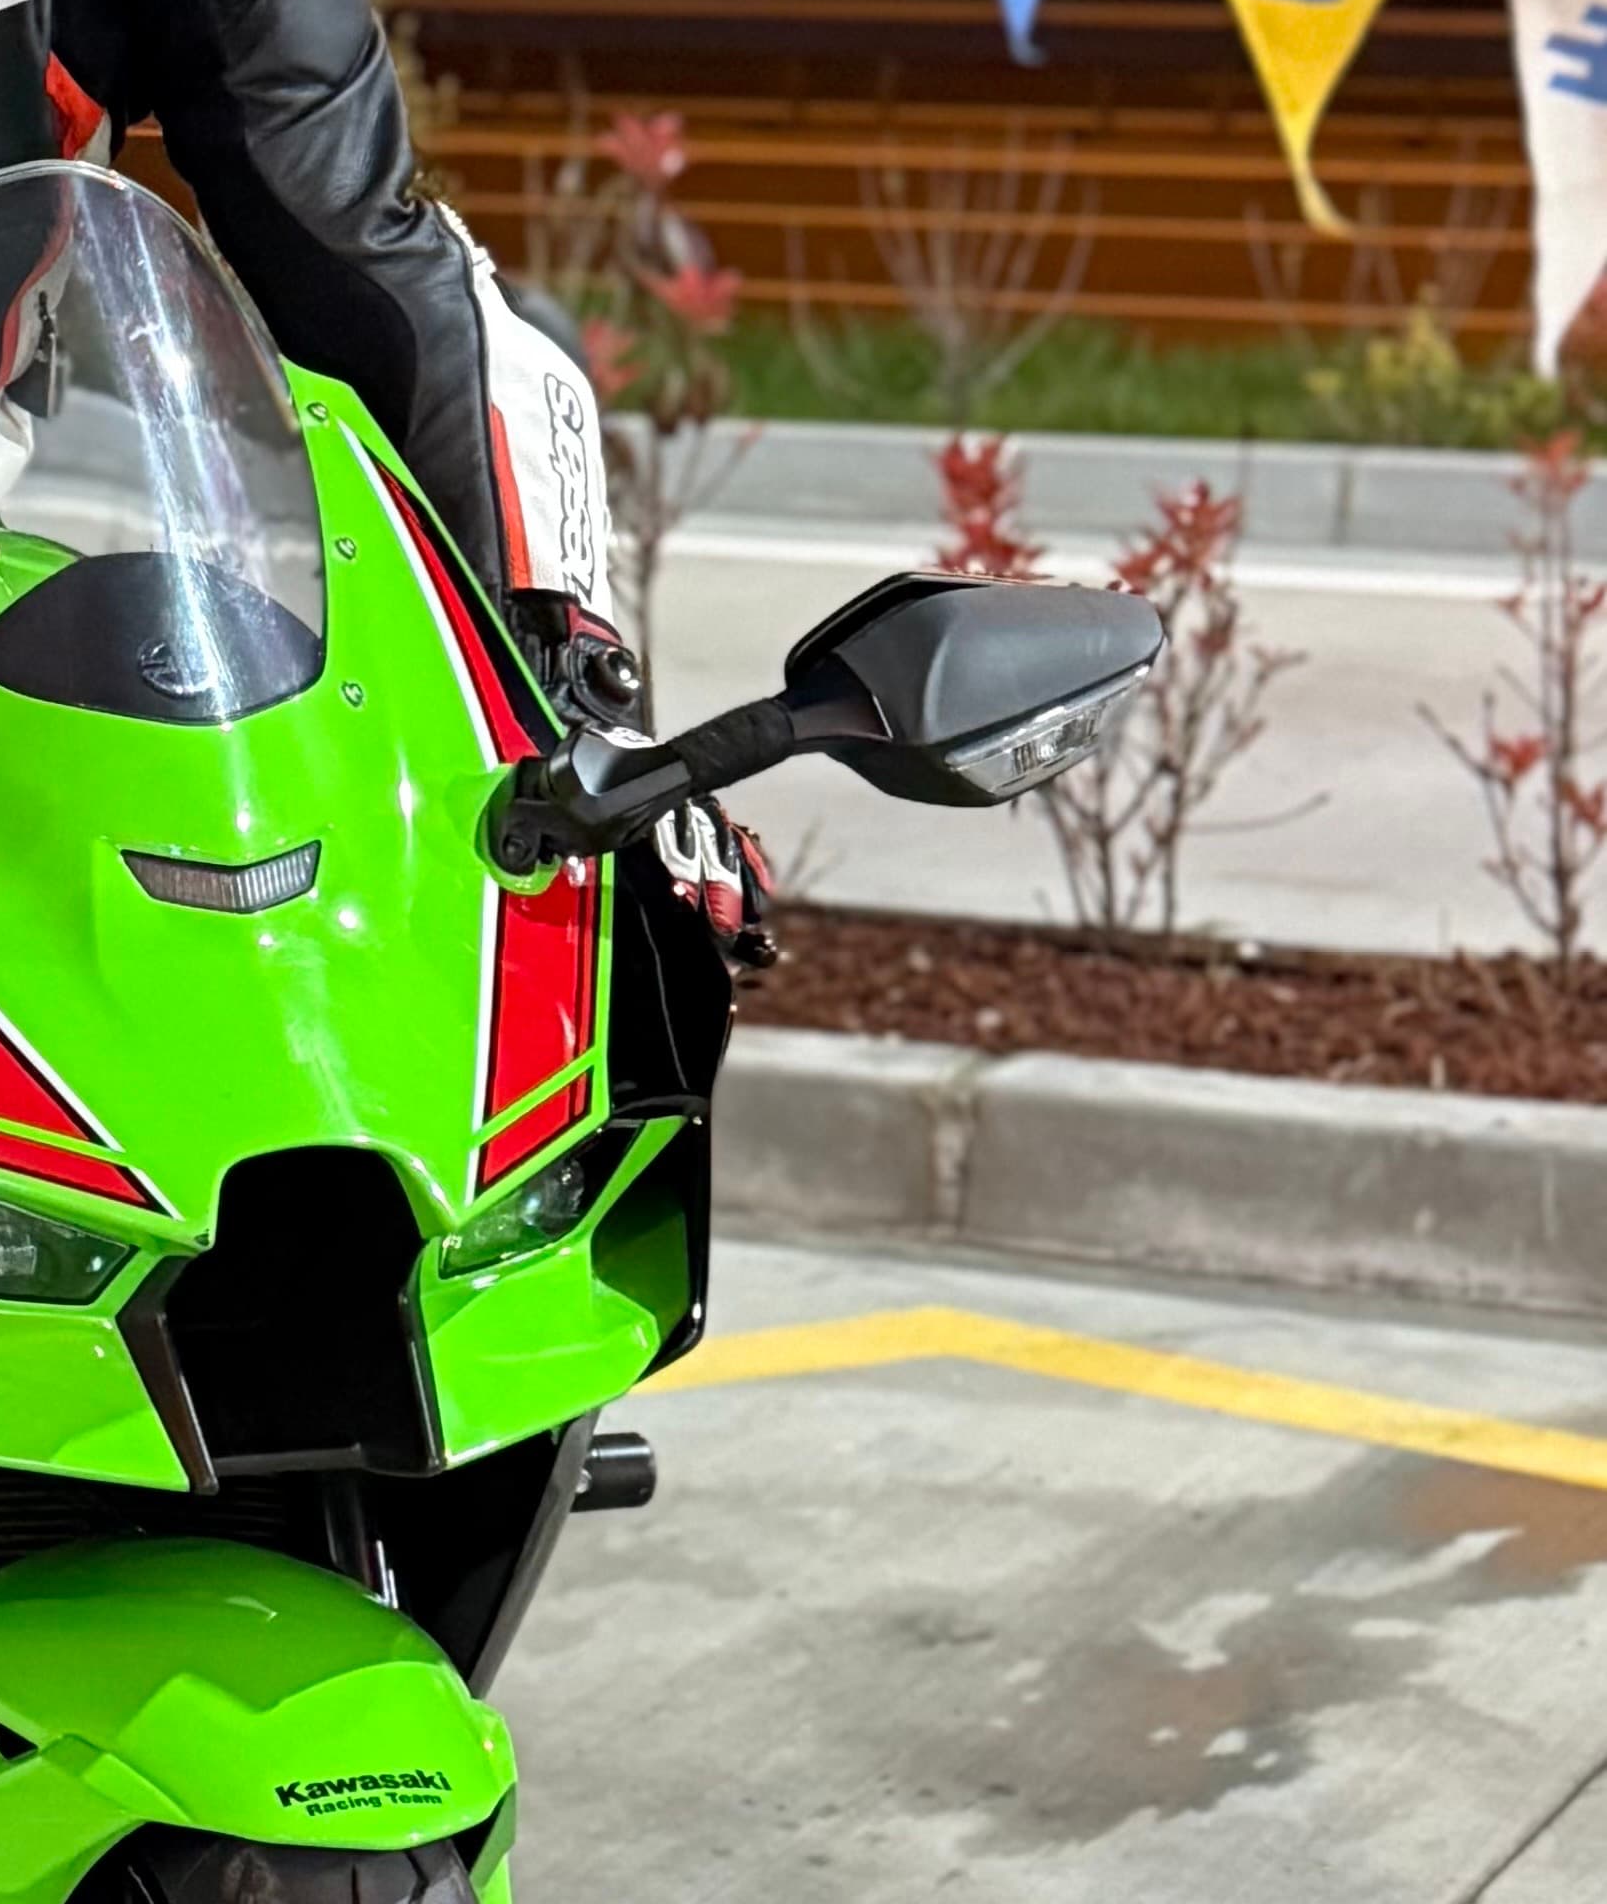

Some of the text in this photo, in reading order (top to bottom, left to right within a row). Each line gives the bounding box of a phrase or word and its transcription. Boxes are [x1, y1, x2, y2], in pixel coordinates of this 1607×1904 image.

[274, 1769, 452, 1808] Kawasaki
[305, 1791, 443, 1817] Racing Team
